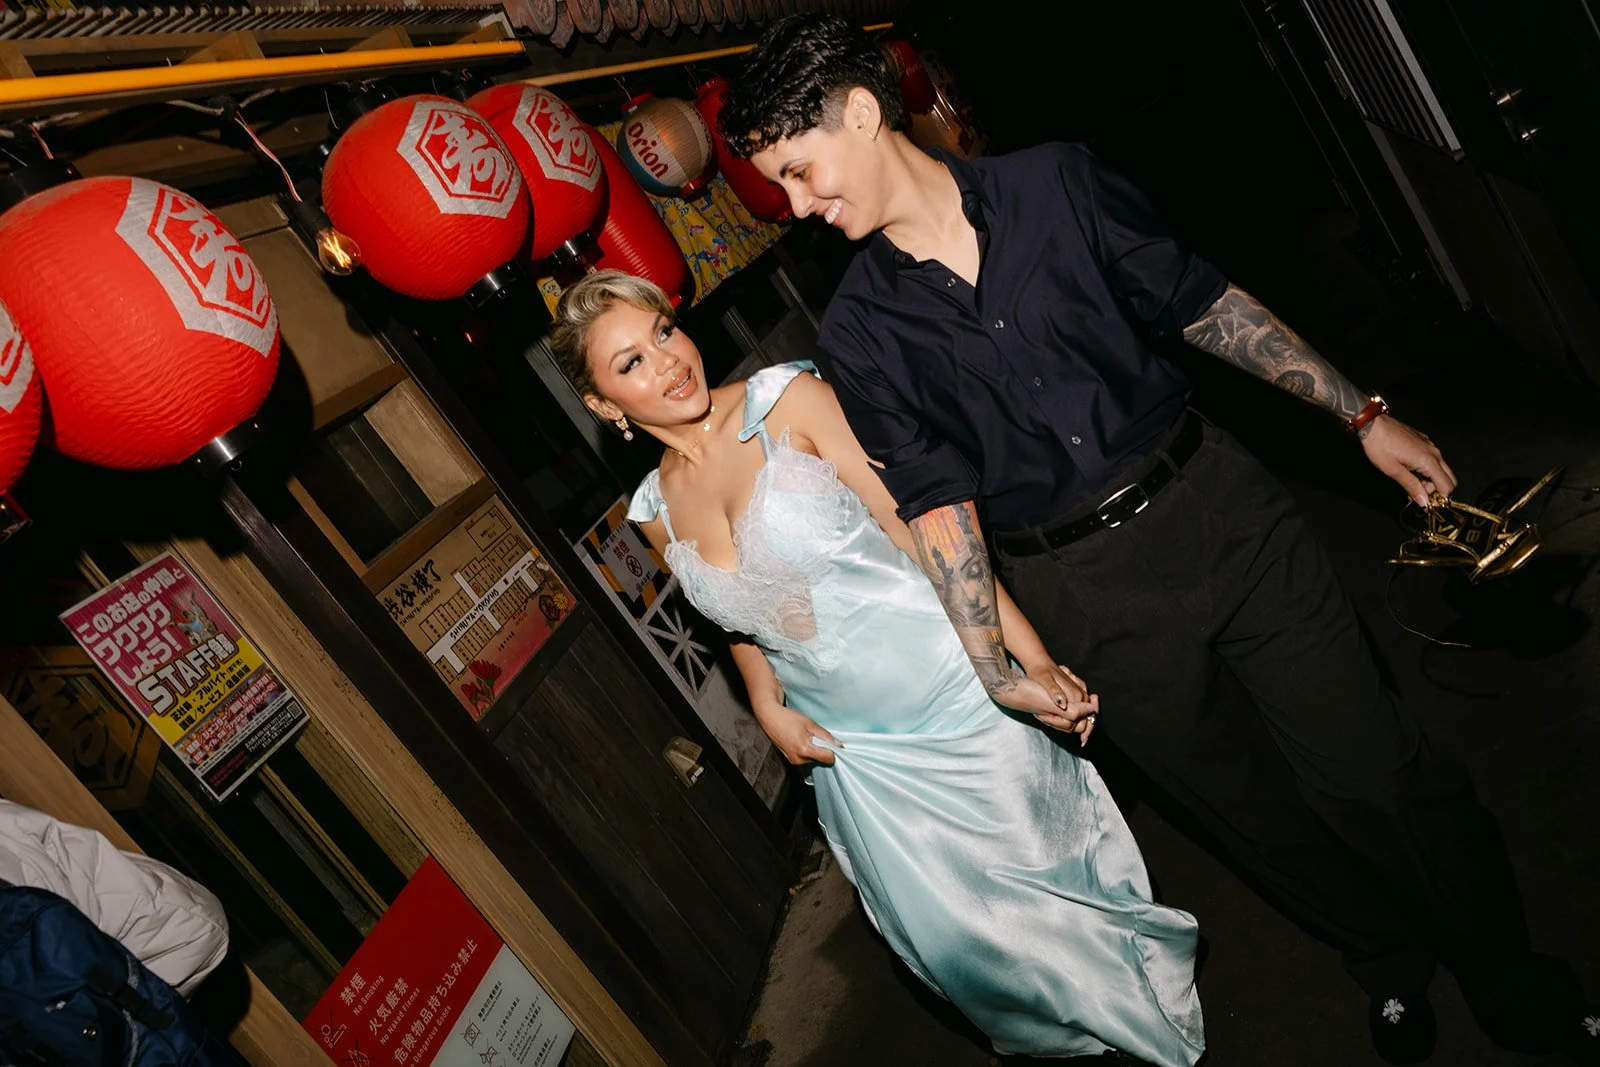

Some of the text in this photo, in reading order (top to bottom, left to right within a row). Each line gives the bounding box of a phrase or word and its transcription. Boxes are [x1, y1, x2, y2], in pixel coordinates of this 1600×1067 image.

[628, 122, 669, 178] Orion
[77, 567, 185, 644] このお店の仲間と
[93, 600, 171, 666] ワクワク
[339, 972, 367, 1006] 禁煙
[353, 974, 385, 1016] No Smoking
[369, 976, 409, 1036] 火気厳禁
[380, 987, 420, 1046] No Naked Flames
[394, 938, 478, 1065] 危険物品持ち込み禁止
[413, 1026, 438, 1063] Dangerous
[436, 1005, 451, 1026] Goods
